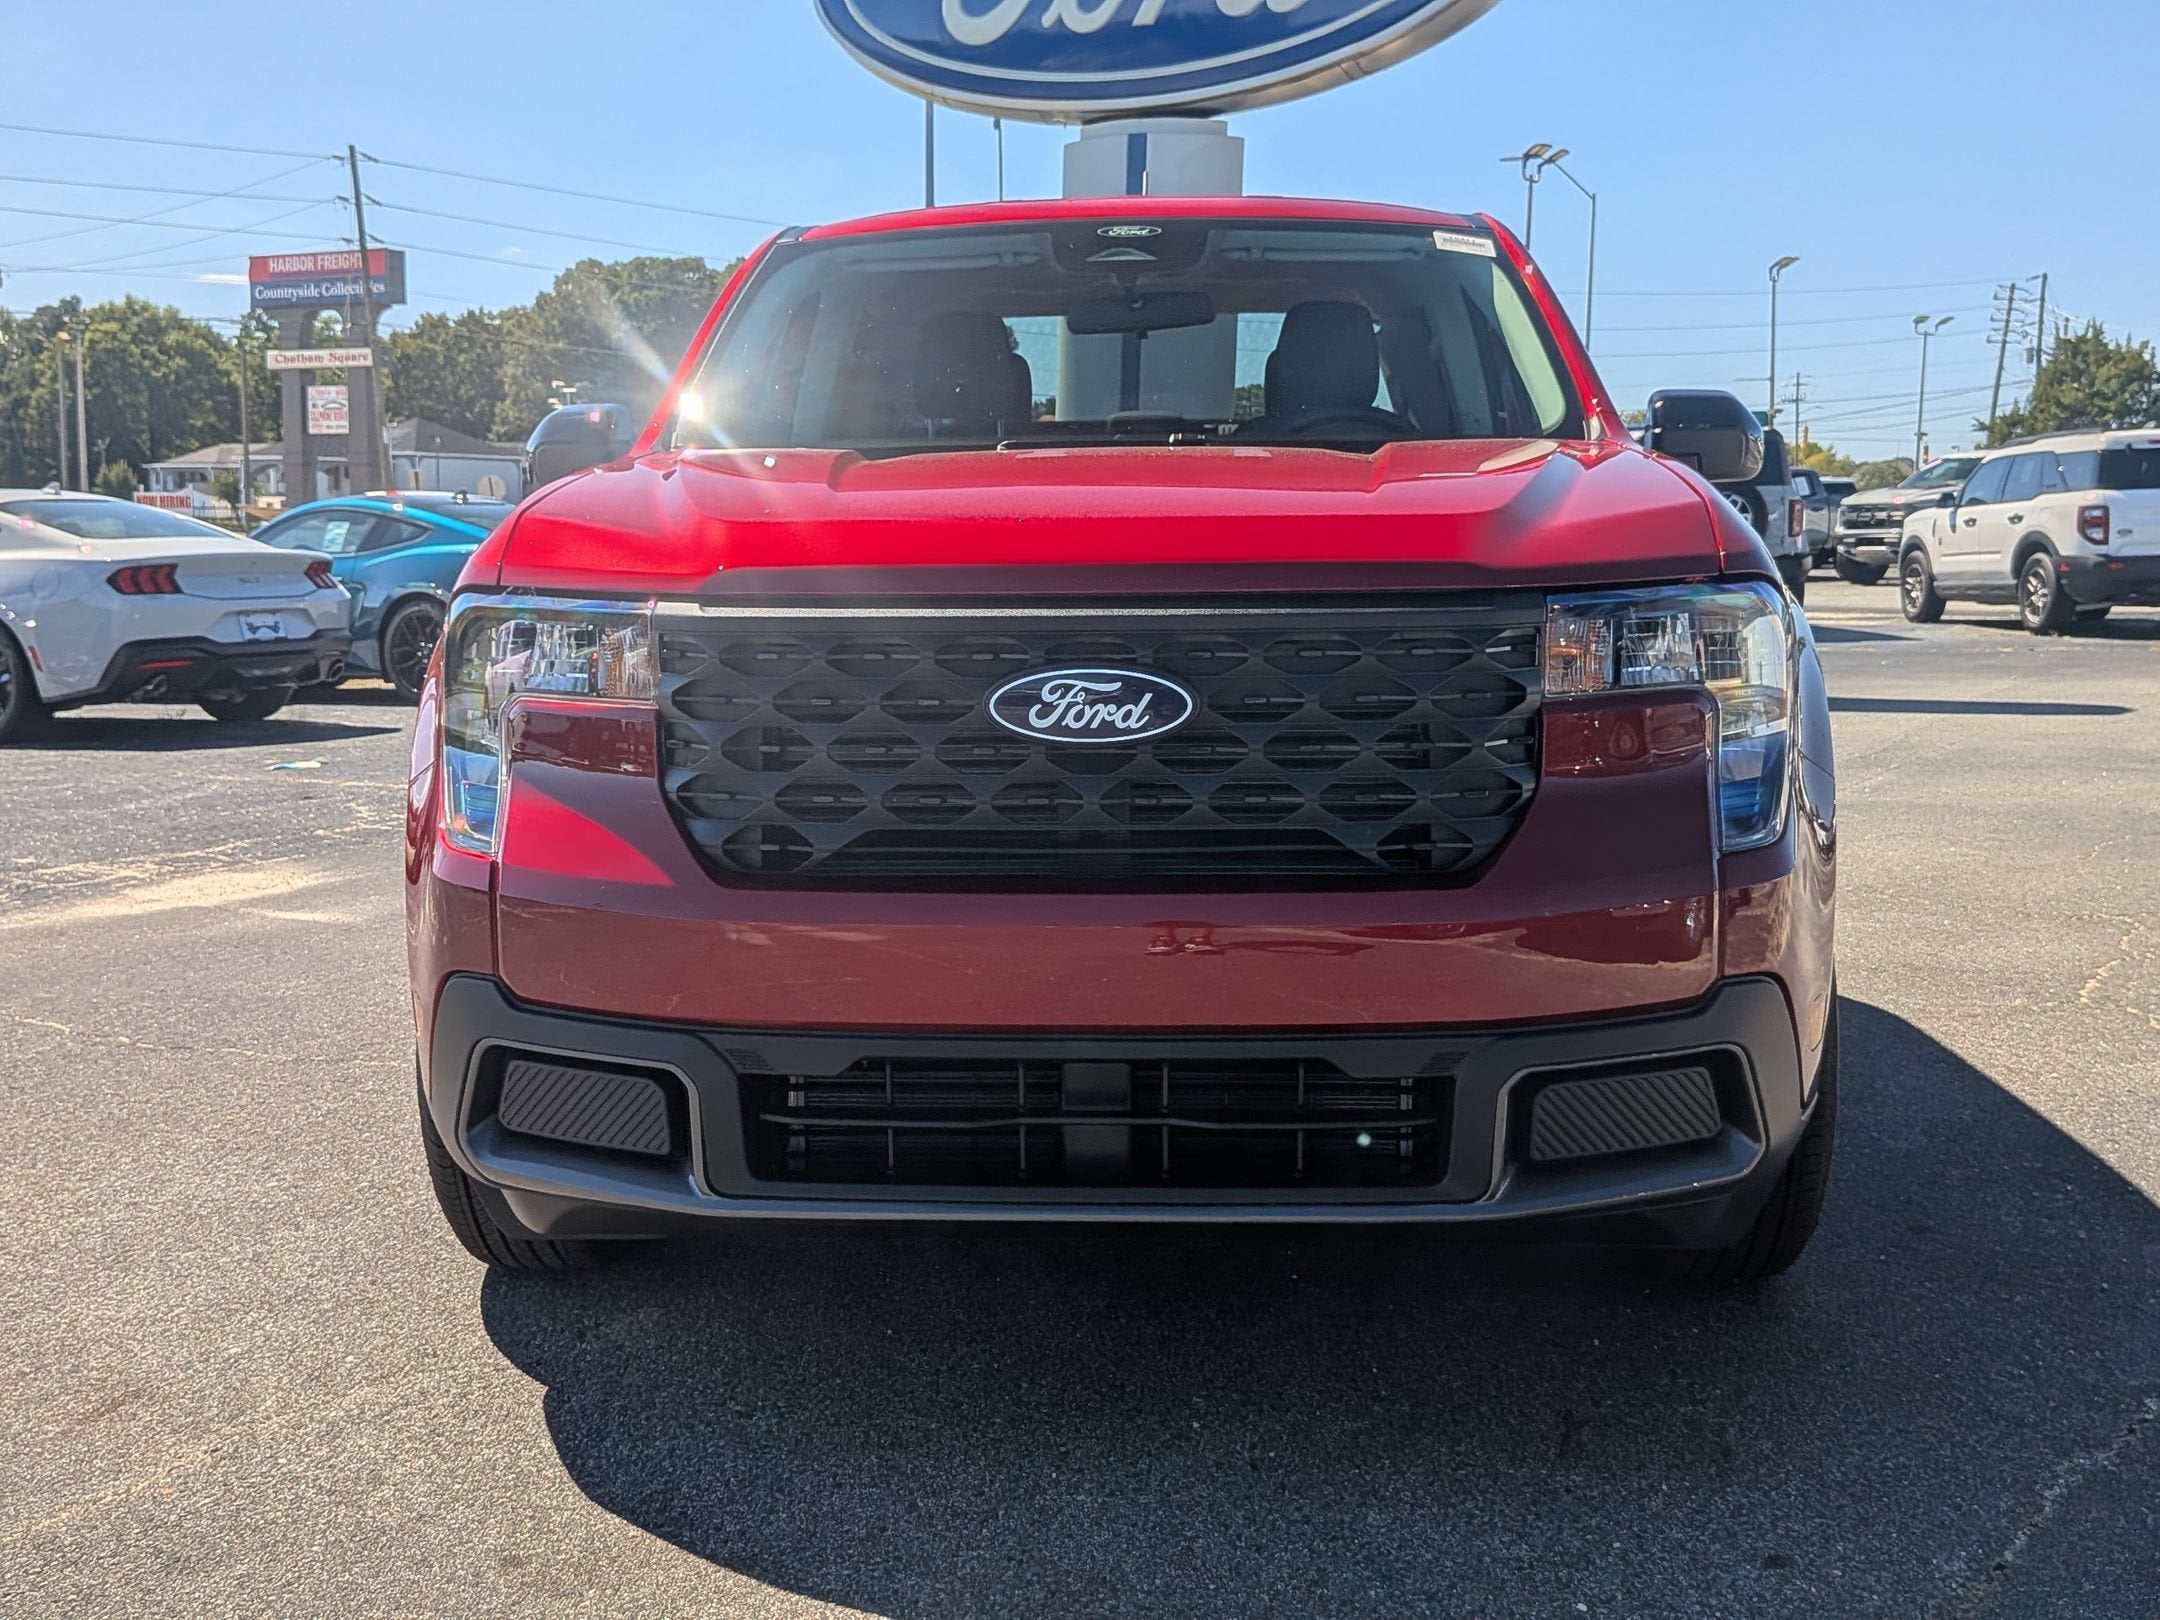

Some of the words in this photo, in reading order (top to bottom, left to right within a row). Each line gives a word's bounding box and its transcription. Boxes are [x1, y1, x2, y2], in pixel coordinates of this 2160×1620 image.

[1108, 226, 1150, 236] Ford
[269, 255, 315, 273] HARBOR
[255, 282, 320, 302] Countryside
[321, 279, 386, 298] Collectiles
[275, 354, 324, 365] Chatham
[329, 352, 368, 363] Square
[159, 495, 192, 509] HIRING
[1028, 679, 1154, 729] Ford
